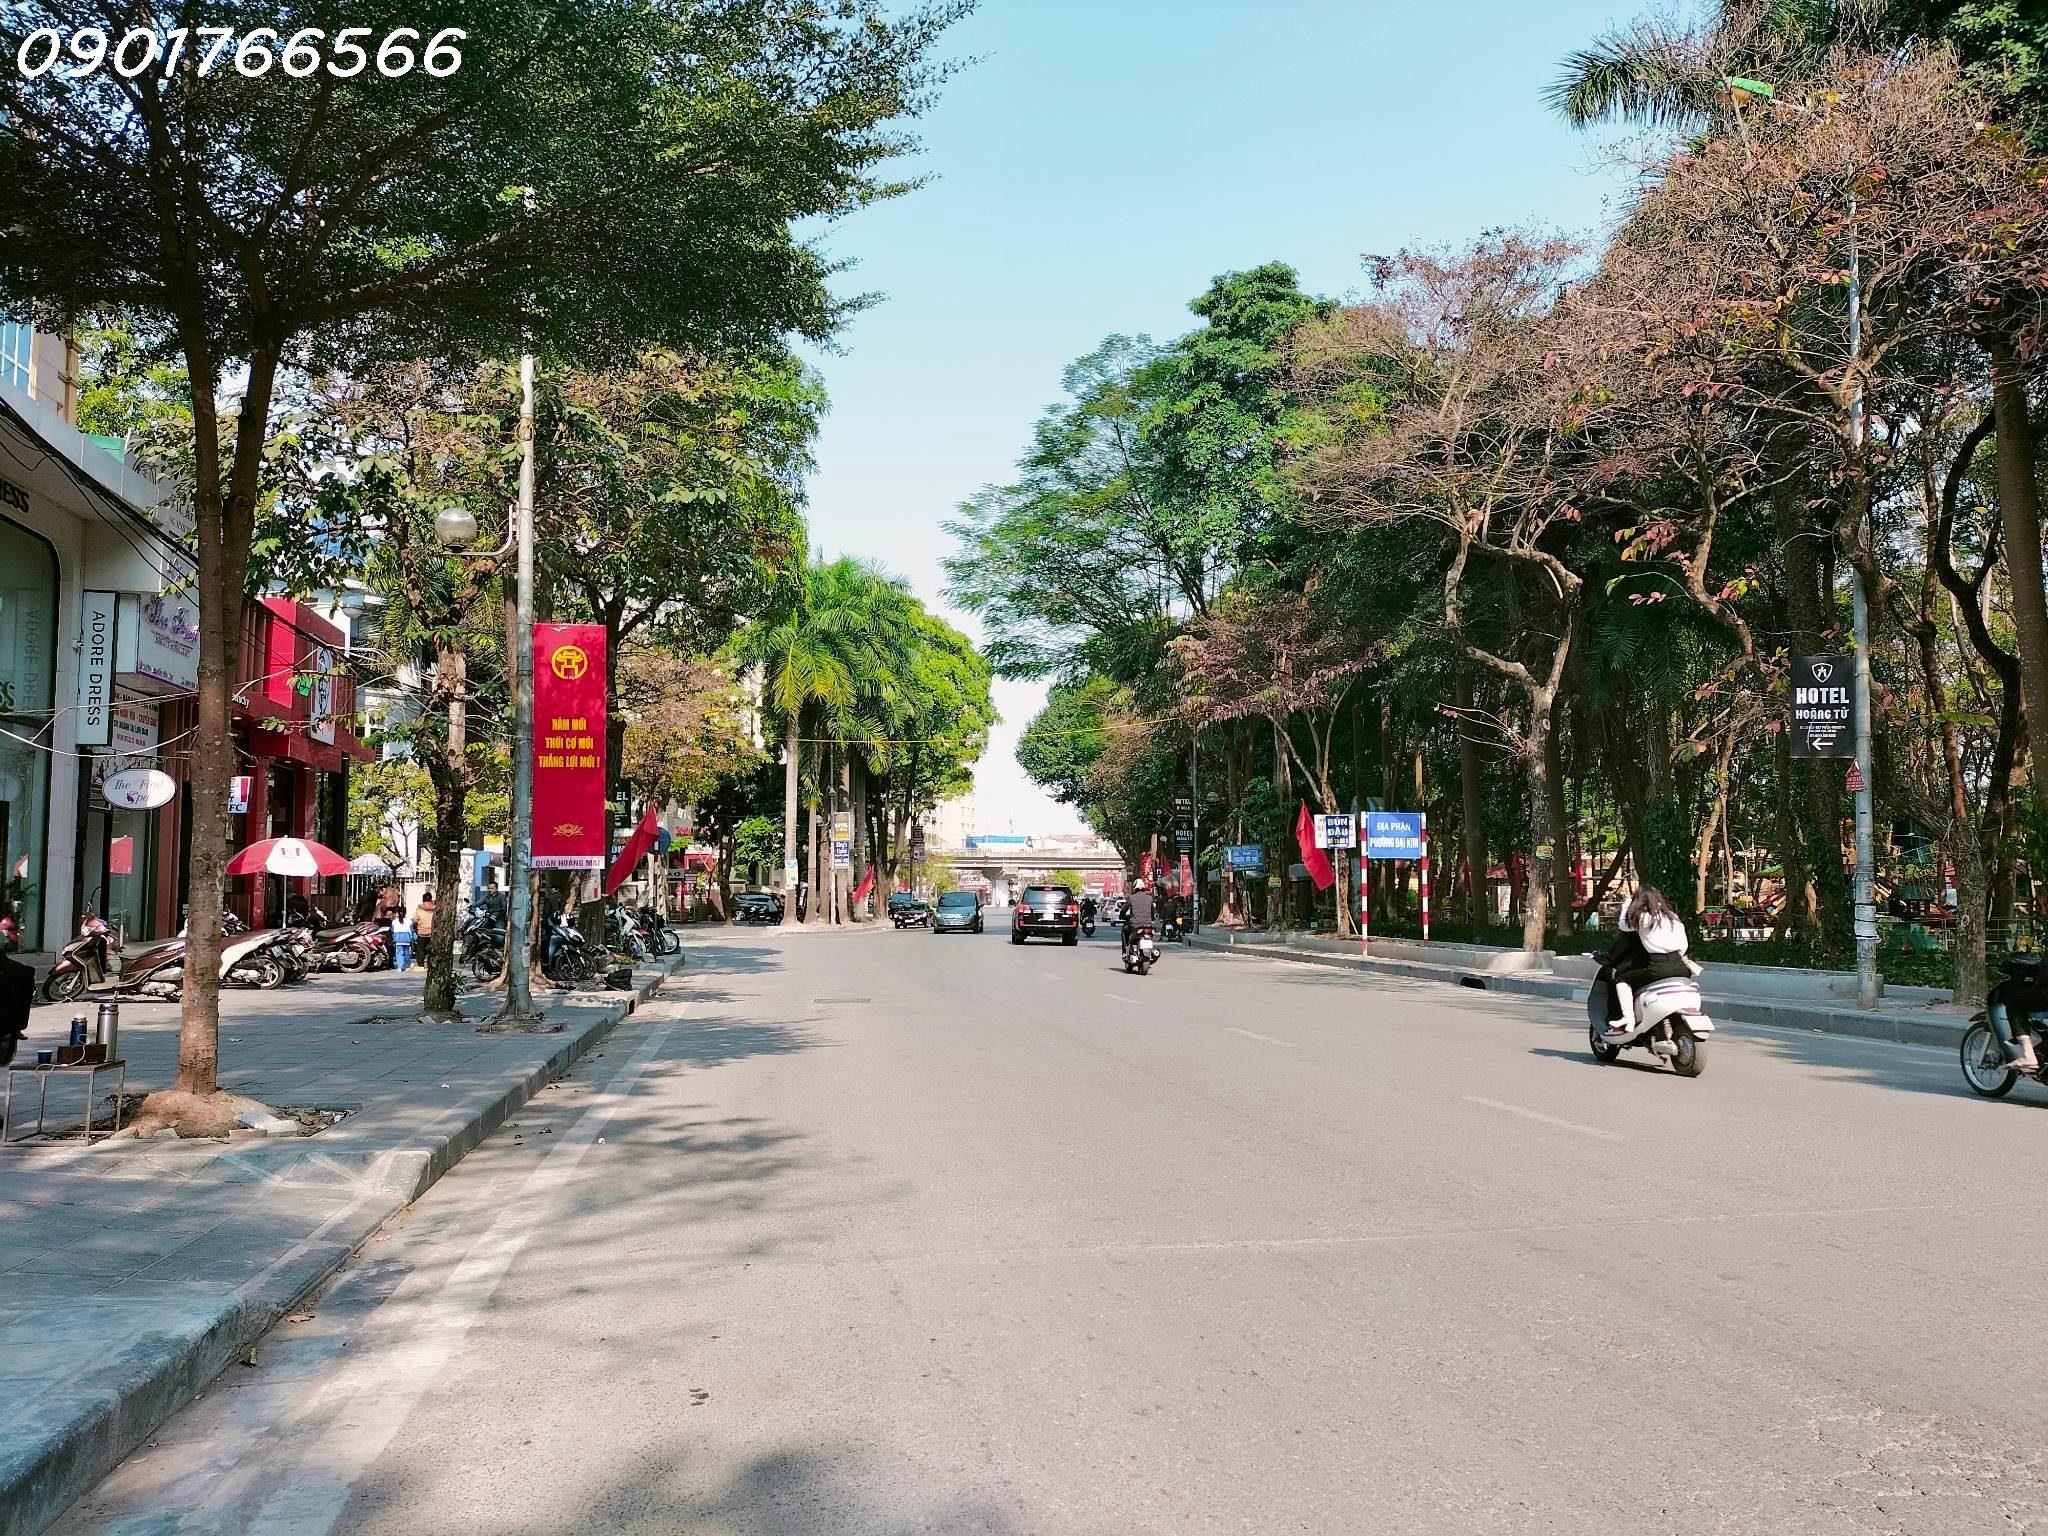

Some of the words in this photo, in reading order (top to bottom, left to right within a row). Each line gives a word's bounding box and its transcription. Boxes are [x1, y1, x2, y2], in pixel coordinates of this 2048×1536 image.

[90, 610, 106, 666] ADORE
[87, 673, 103, 726] DRESS
[1795, 687, 1850, 704] HOTEL
[551, 717, 570, 731] NĂM
[571, 716, 587, 731] MỚI
[565, 736, 577, 750] CƠ
[578, 735, 594, 750] MỚI
[538, 753, 564, 768] THẮNG
[565, 754, 578, 770] LỢI
[579, 754, 595, 768] MỚI
[228, 803, 243, 812] FC
[1327, 816, 1348, 826] BÚN
[1376, 822, 1389, 833] ĐỊA
[1390, 822, 1411, 833] PHẬN
[1406, 837, 1419, 849] KIM
[535, 858, 556, 869] QUẬN
[558, 858, 584, 867] HOÀNG
[585, 859, 601, 867] MAI
